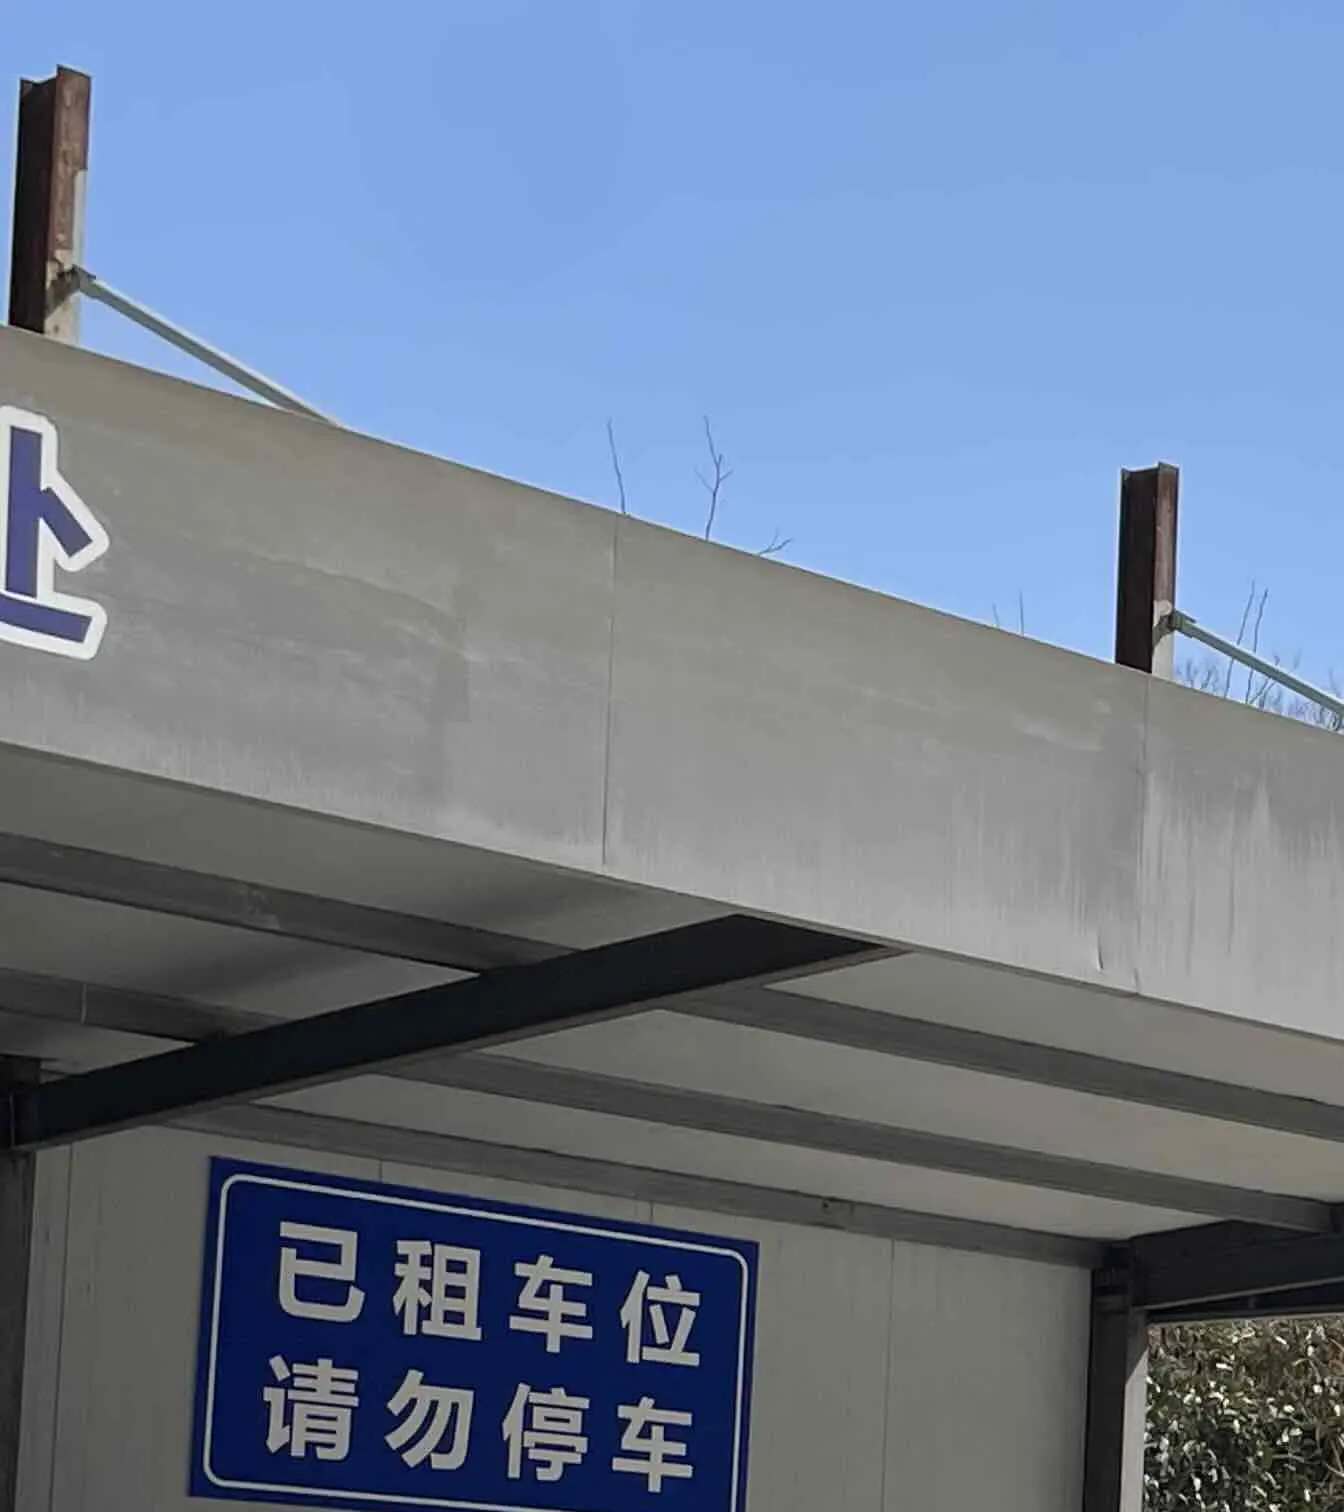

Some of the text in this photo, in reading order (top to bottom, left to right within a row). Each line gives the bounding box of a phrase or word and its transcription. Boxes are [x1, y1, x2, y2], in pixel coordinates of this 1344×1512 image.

[277, 1220, 701, 1368] 已租车位
[263, 1354, 694, 1494] 请勿停车
